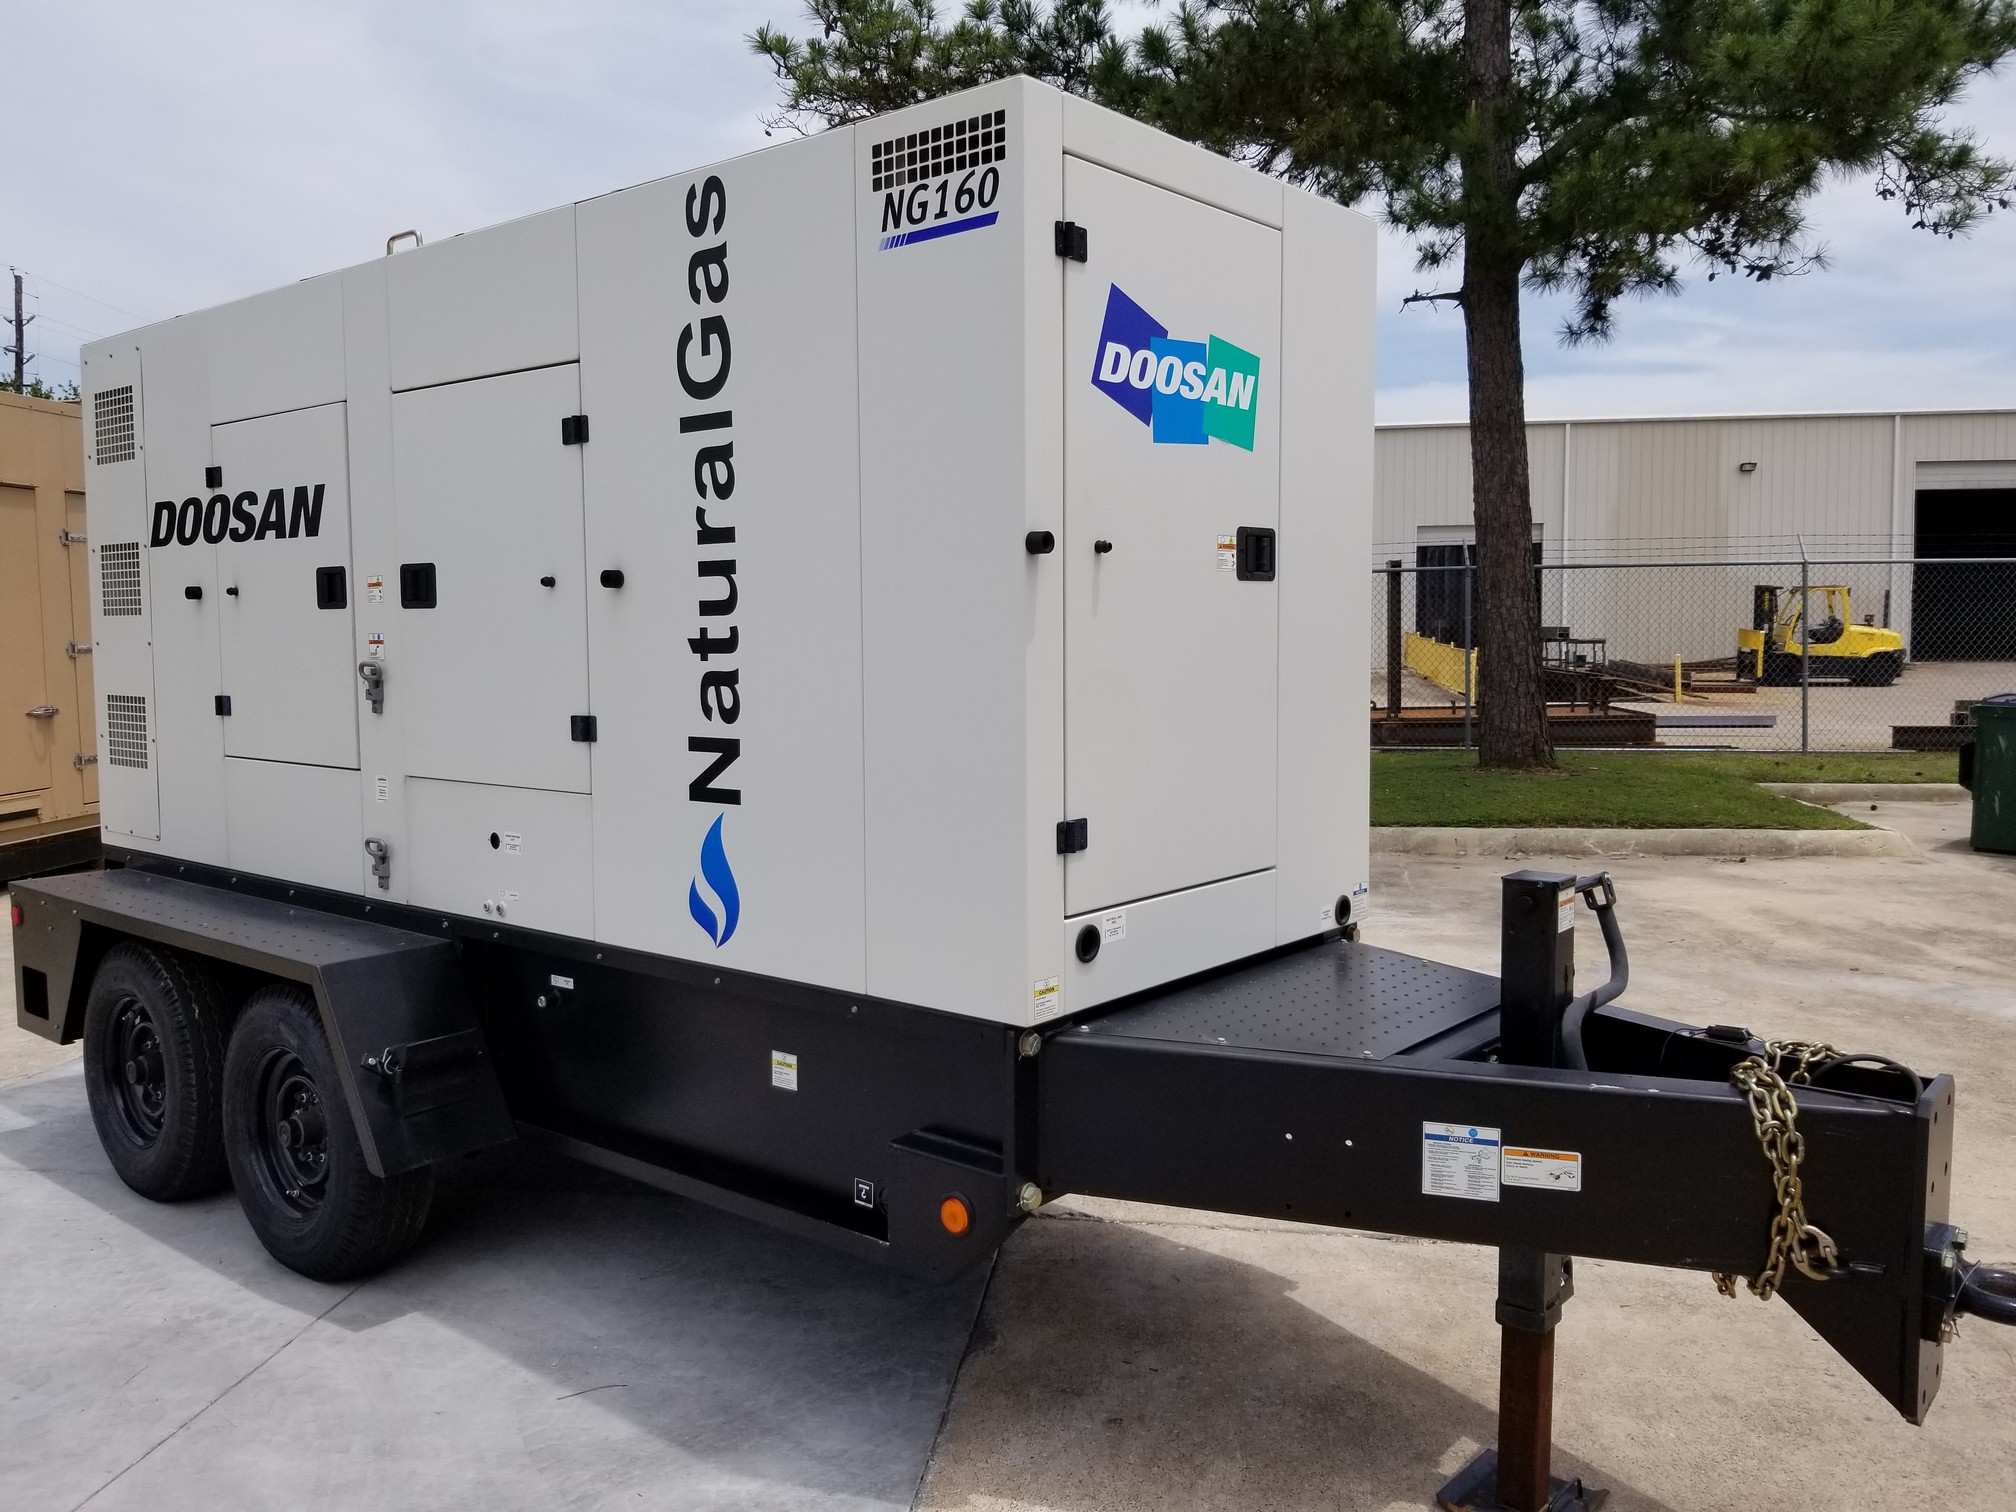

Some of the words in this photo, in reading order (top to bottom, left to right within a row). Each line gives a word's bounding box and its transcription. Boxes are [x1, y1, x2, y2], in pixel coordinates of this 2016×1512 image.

[881, 166, 1000, 233] NG160
[1098, 341, 1256, 411] DOOSAN
[150, 483, 326, 548] DOOSAN
[1448, 1136, 1474, 1144] NOTICE
[1530, 1151, 1560, 1160] WARNING
